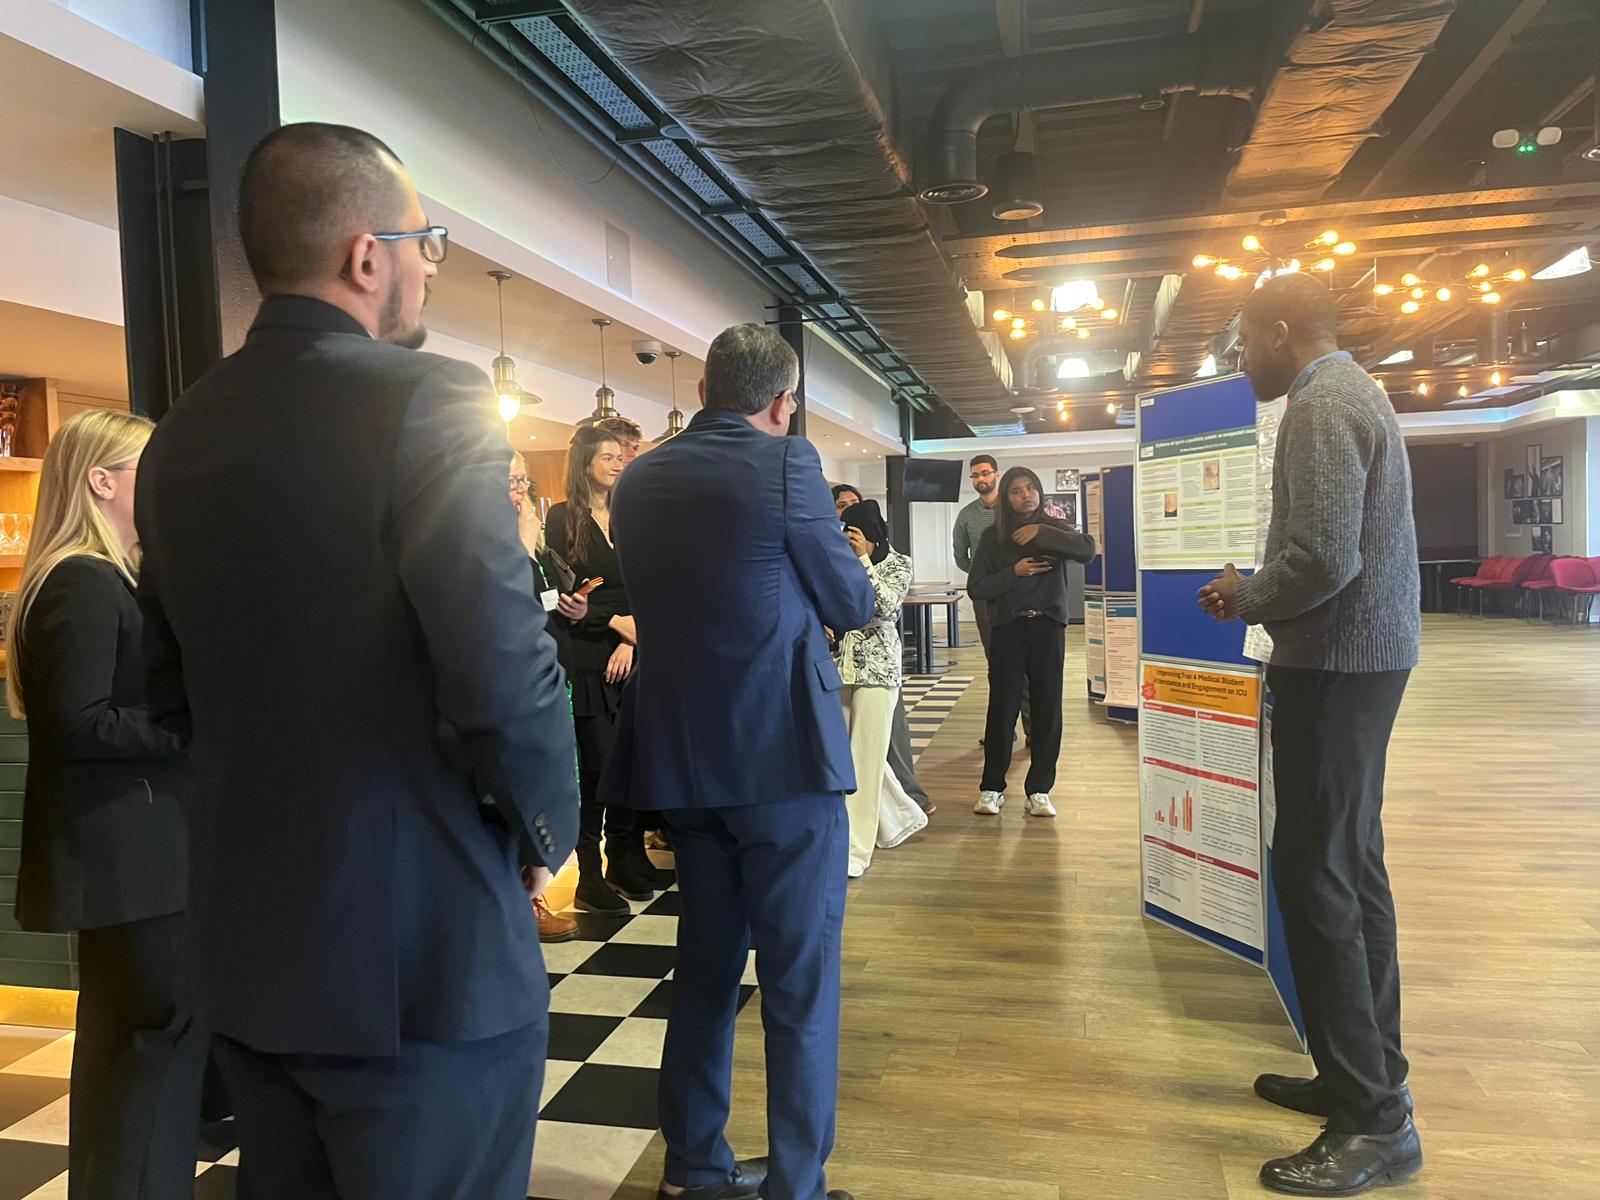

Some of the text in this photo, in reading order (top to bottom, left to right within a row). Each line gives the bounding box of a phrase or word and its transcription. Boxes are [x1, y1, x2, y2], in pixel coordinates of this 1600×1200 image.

[1198, 674, 1221, 683] Medical
[1222, 677, 1244, 687] Student
[1192, 682, 1226, 694] Engagement
[1236, 688, 1248, 697] ICU
